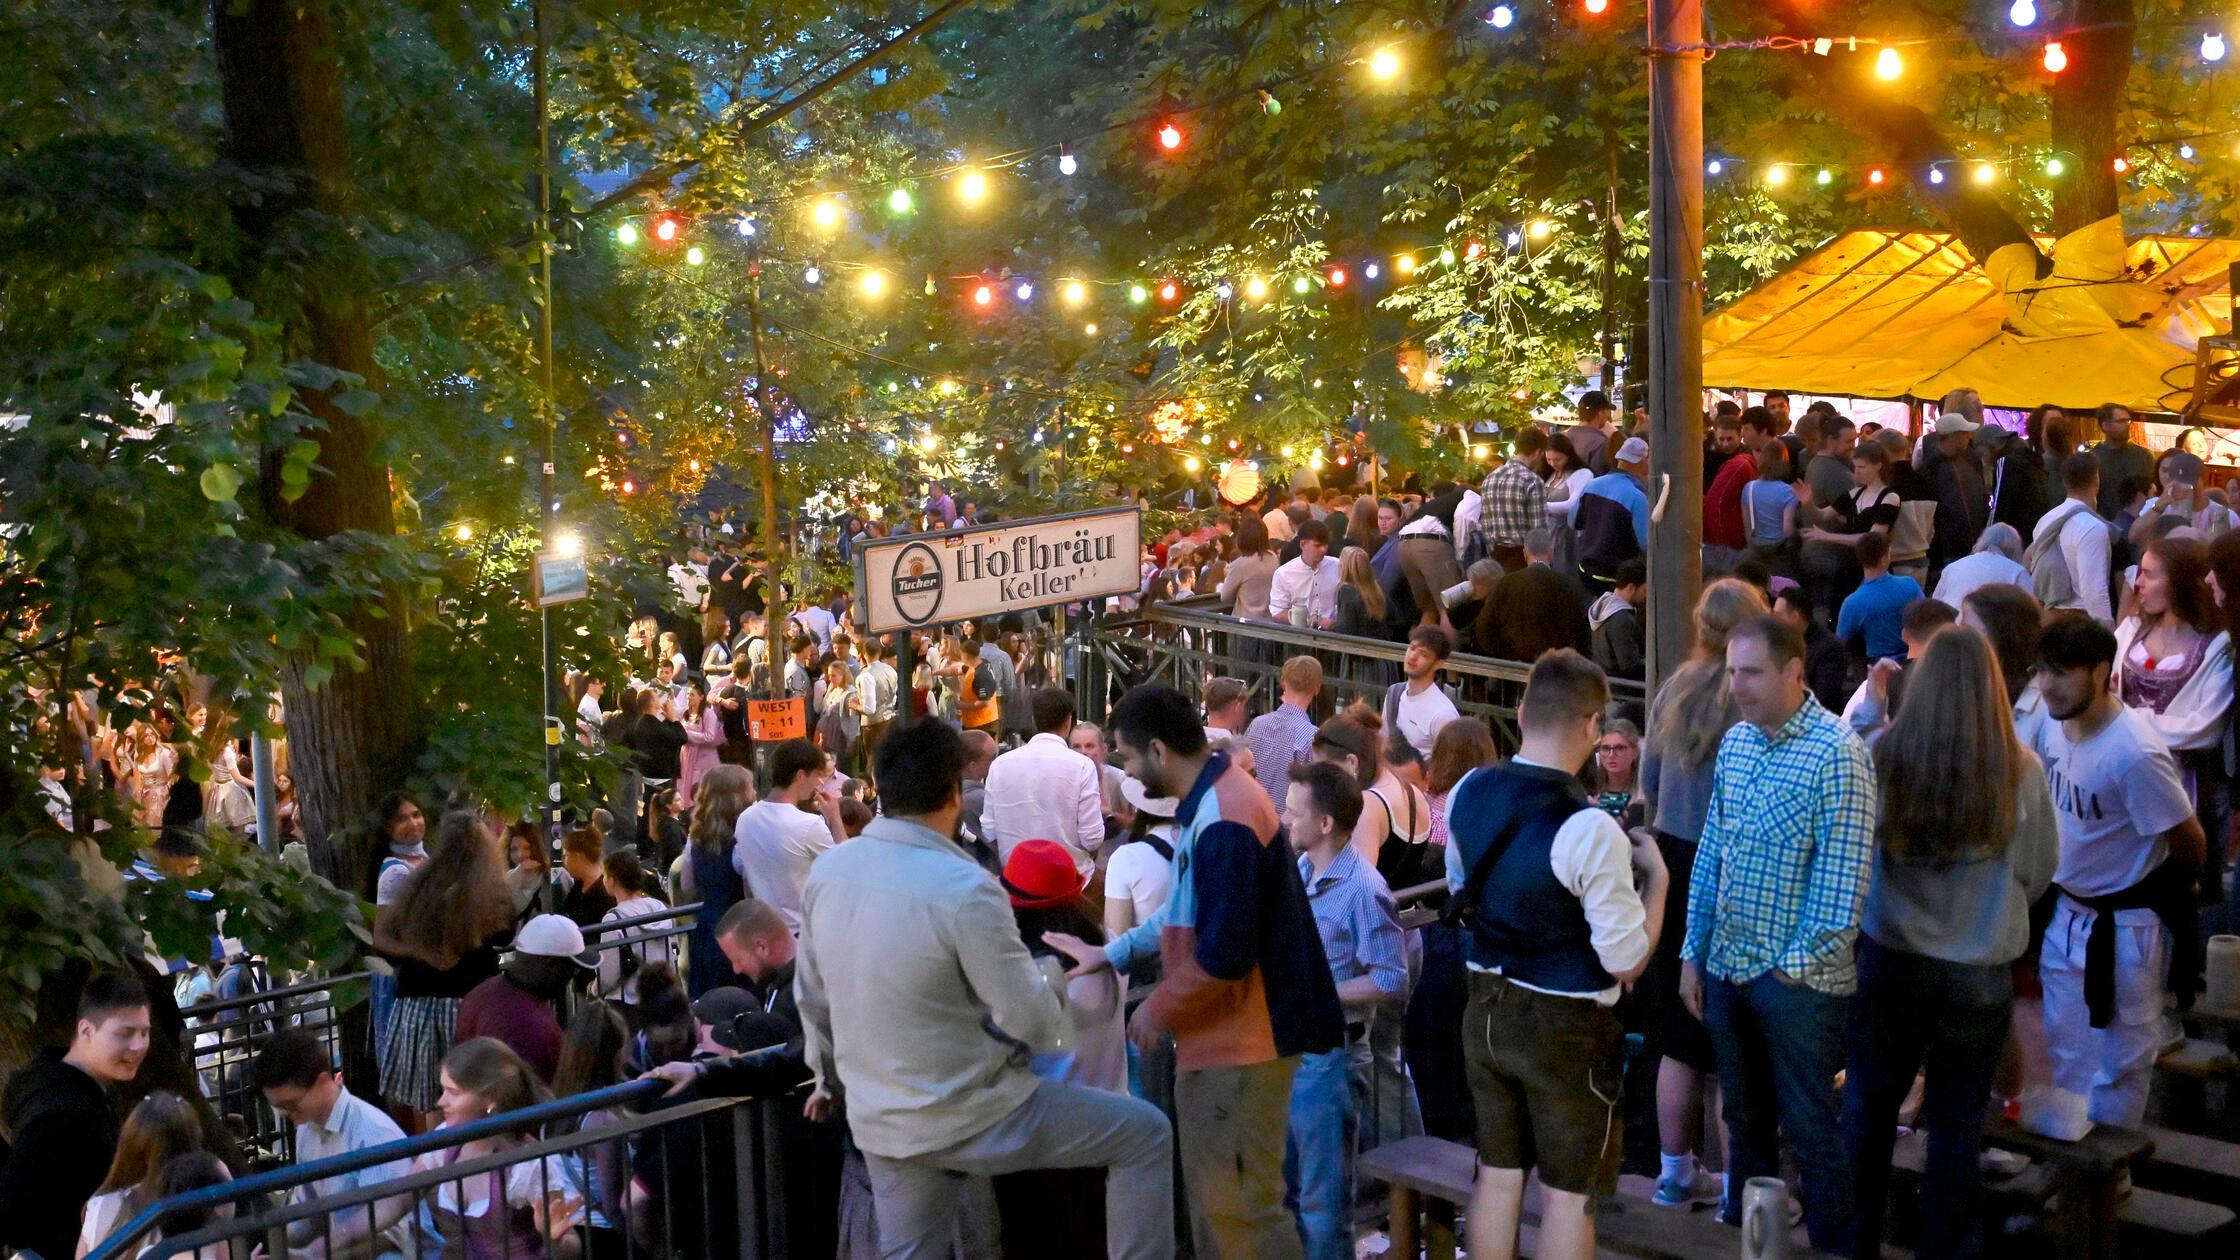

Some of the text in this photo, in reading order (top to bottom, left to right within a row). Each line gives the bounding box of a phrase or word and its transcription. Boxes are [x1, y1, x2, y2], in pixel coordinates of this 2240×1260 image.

[956, 529, 1116, 583] Hofbräu
[899, 579, 937, 592] Tucher
[1000, 572, 1077, 602] Keller
[758, 701, 792, 713] WEST
[760, 718, 765, 728] 1
[780, 716, 793, 727] 11
